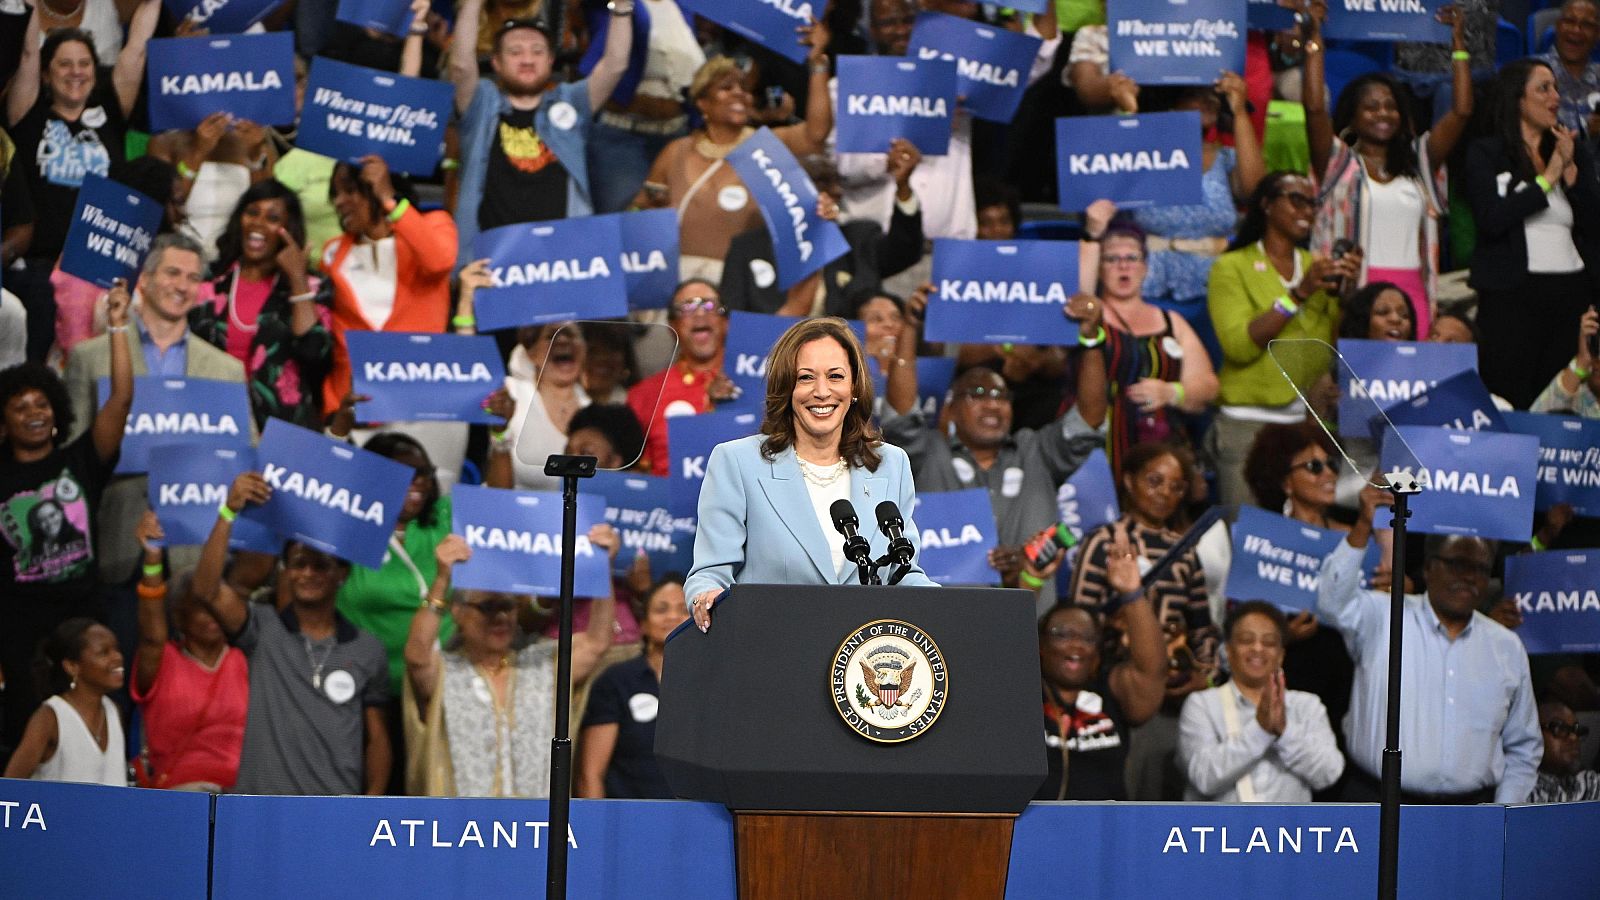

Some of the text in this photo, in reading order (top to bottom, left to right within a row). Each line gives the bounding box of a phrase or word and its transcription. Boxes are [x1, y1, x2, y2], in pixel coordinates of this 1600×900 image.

[1117, 18, 1239, 40] When we fight,
[1133, 40, 1222, 57] WE WIN.
[161, 70, 282, 95] KAMALA
[313, 87, 438, 130] When we fight,
[847, 94, 948, 118] KAMALA
[327, 112, 417, 147] WE WIN.
[1069, 149, 1190, 175] KAMALA
[751, 148, 813, 262] KAMALA
[81, 203, 118, 234] When
[87, 232, 115, 257] WE
[940, 279, 1067, 304] KAMALA
[364, 361, 493, 381] KAMALA
[1559, 449, 1583, 464] we
[264, 462, 384, 527] KAMALA
[622, 528, 677, 554] WIN.
[1243, 534, 1295, 565] When
[1257, 560, 1293, 587] WE
[834, 624, 945, 735] VICE PRESIDENT OF THE UNITED STATES
[1162, 826, 1360, 853] ATLANTA
